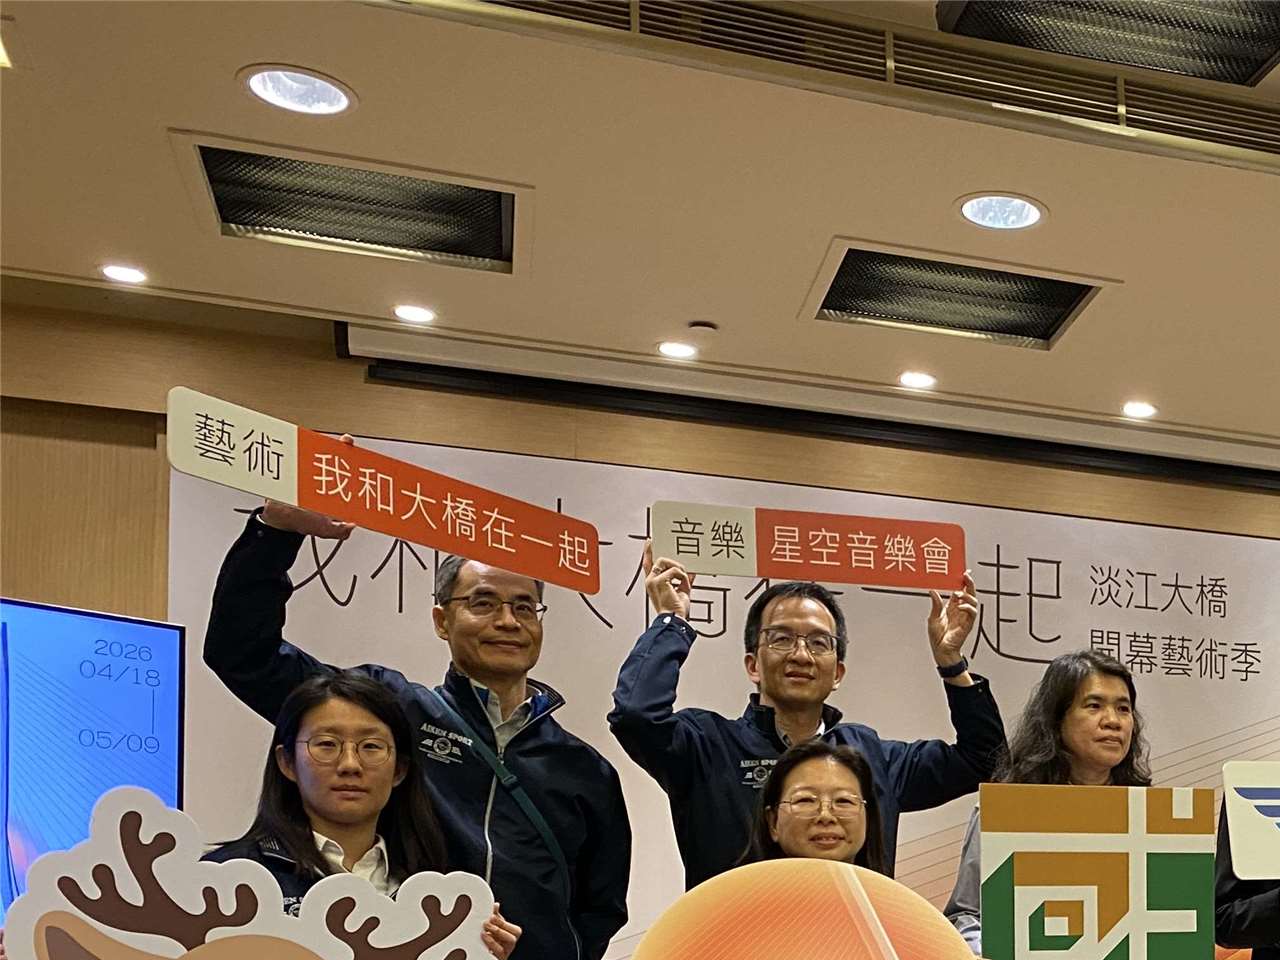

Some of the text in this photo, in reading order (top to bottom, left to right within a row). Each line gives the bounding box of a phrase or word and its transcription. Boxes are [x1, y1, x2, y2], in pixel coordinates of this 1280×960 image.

[194, 412, 592, 577] 藝術 我和大橋在一起
[670, 516, 953, 576] 音樂 星空音樂會
[1089, 565, 1229, 618] 淡江大橋
[94, 639, 153, 662] 2026
[79, 659, 161, 687] 04/18
[78, 728, 160, 754] 05/09
